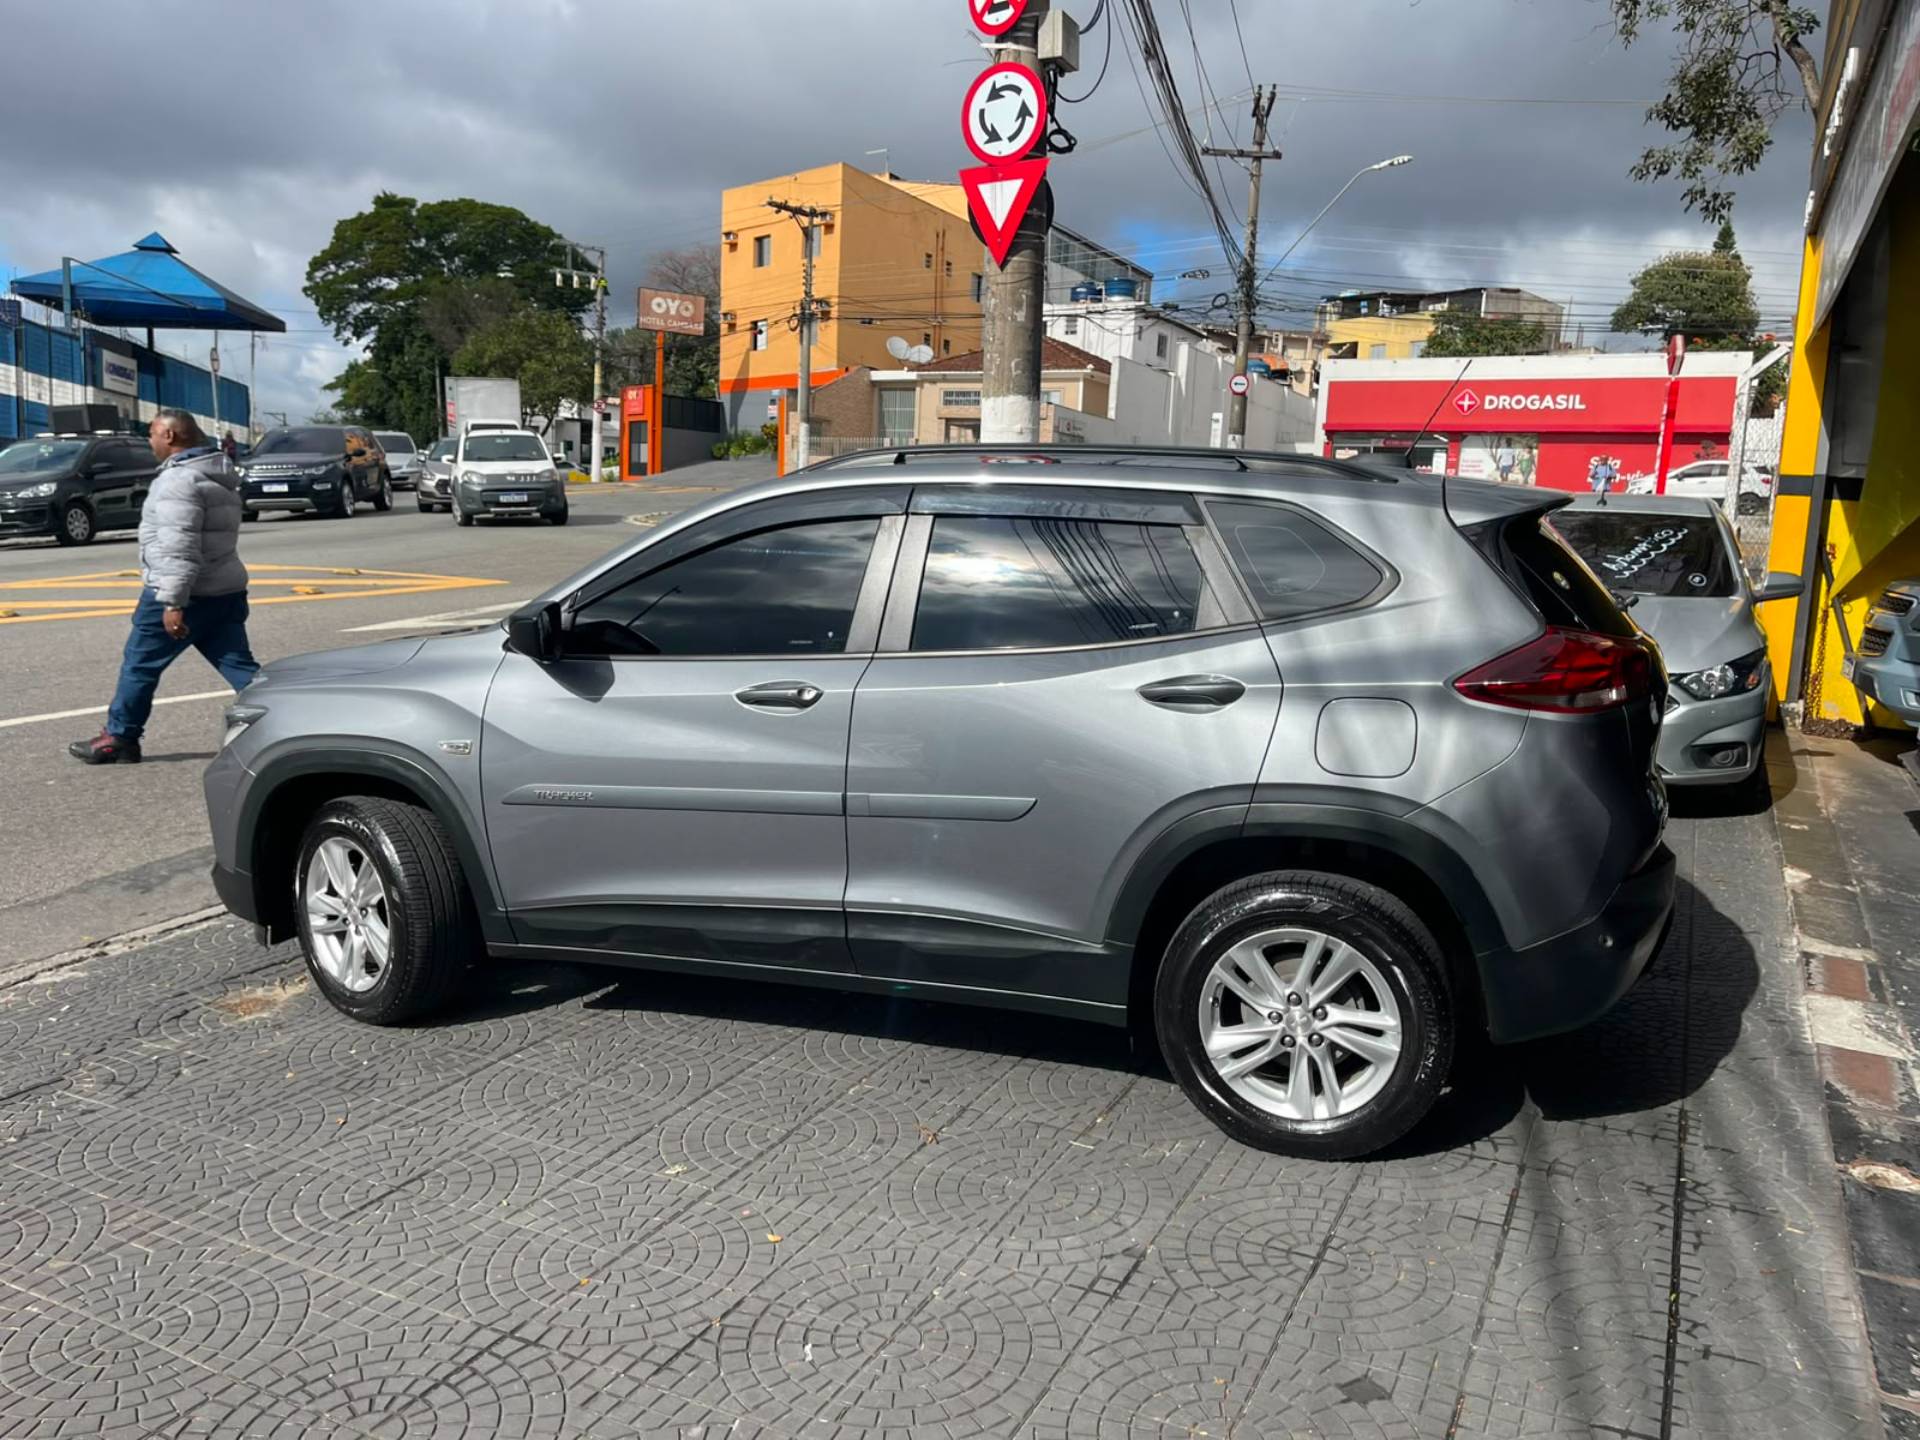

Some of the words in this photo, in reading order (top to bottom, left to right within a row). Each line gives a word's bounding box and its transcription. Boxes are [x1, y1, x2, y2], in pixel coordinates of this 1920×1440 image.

[651, 296, 695, 318] OYO
[1484, 394, 1587, 410] DROGASIL
[533, 790, 593, 800] TRACKER
